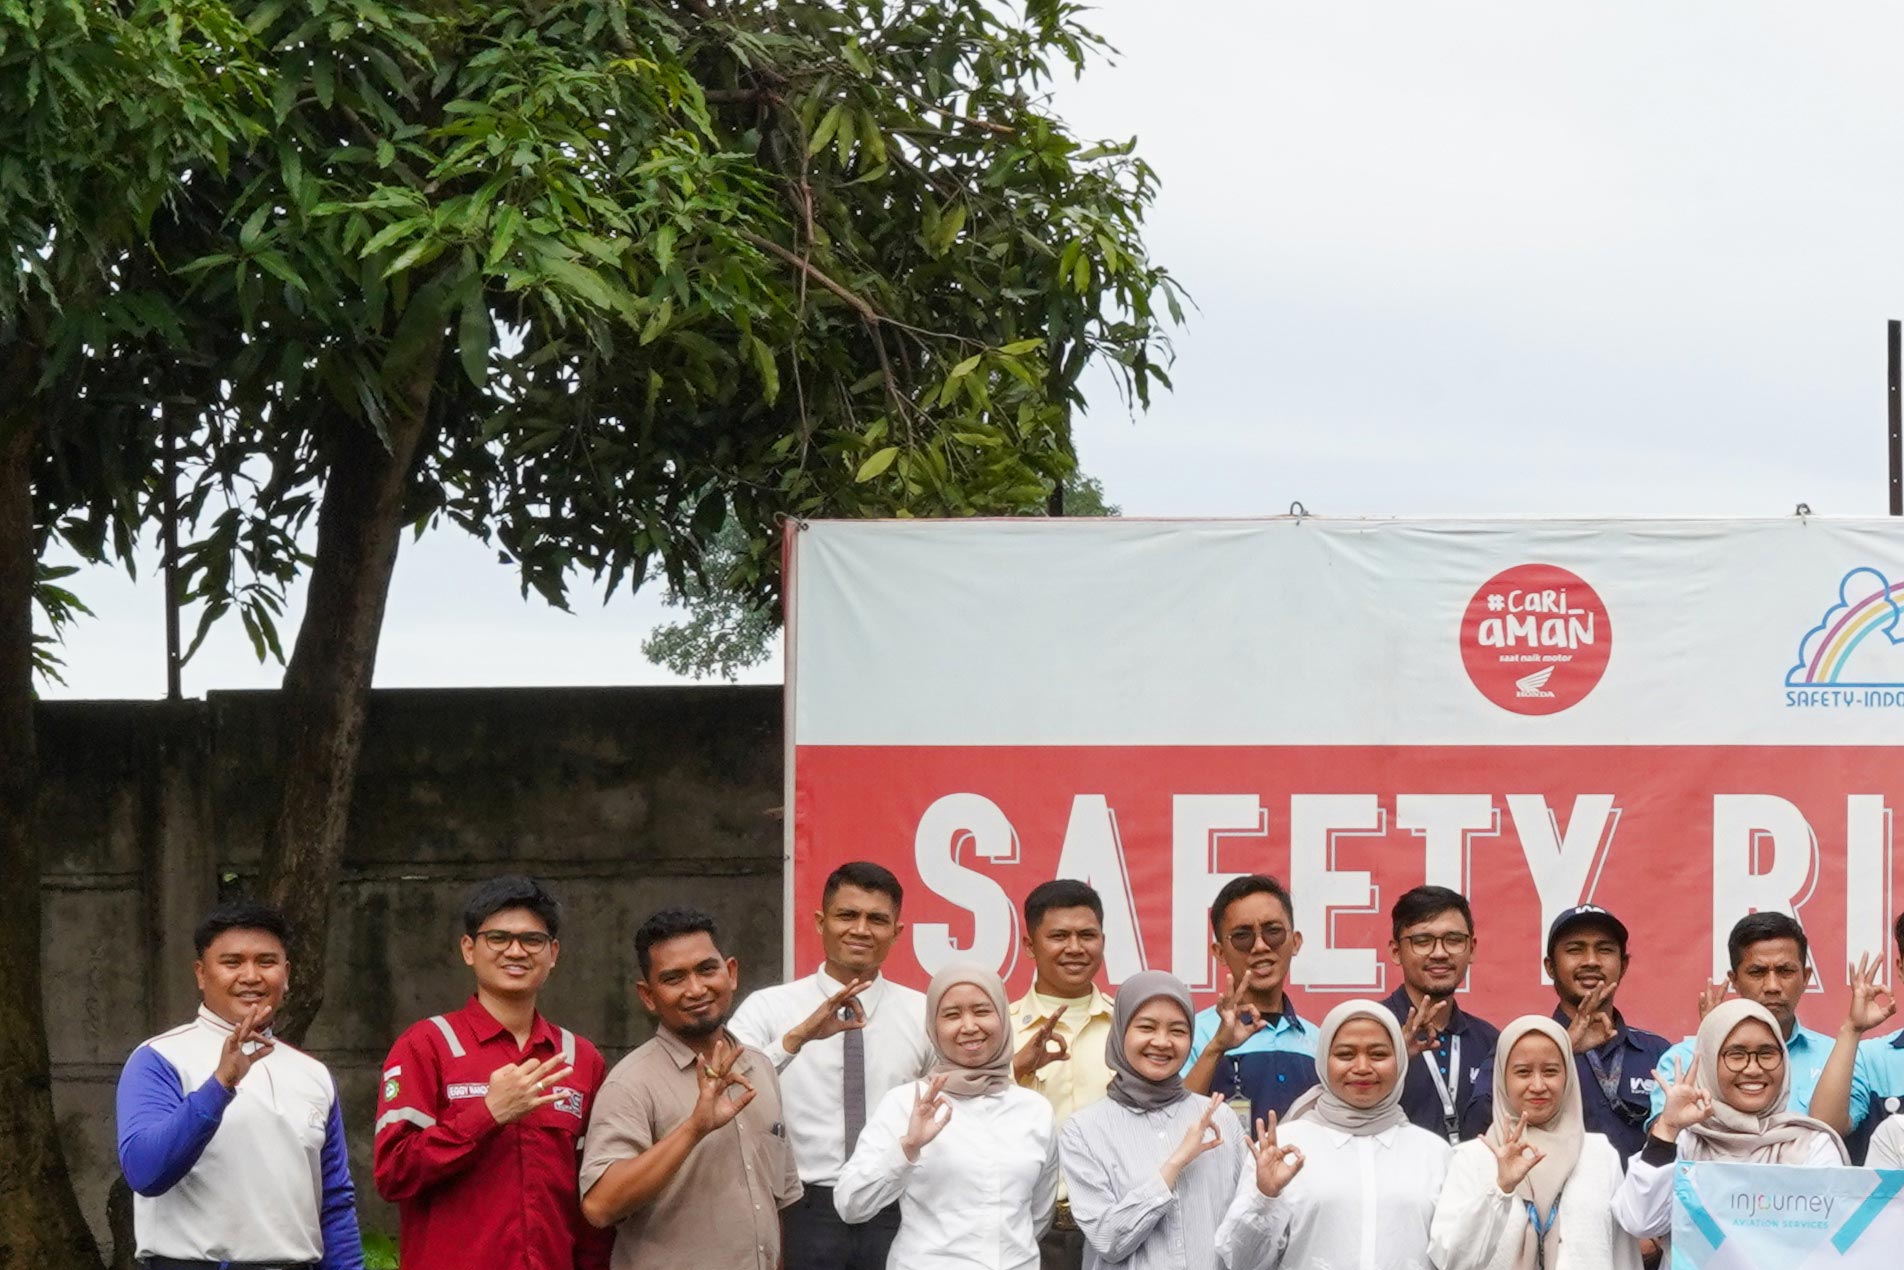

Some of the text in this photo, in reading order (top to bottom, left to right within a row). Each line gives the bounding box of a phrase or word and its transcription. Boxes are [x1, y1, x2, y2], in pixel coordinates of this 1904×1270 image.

[1499, 654, 1572, 662] saat naik motor
[913, 792, 1622, 993] SAFETY
[1732, 1219, 1829, 1229] AVIATION SERVICES
